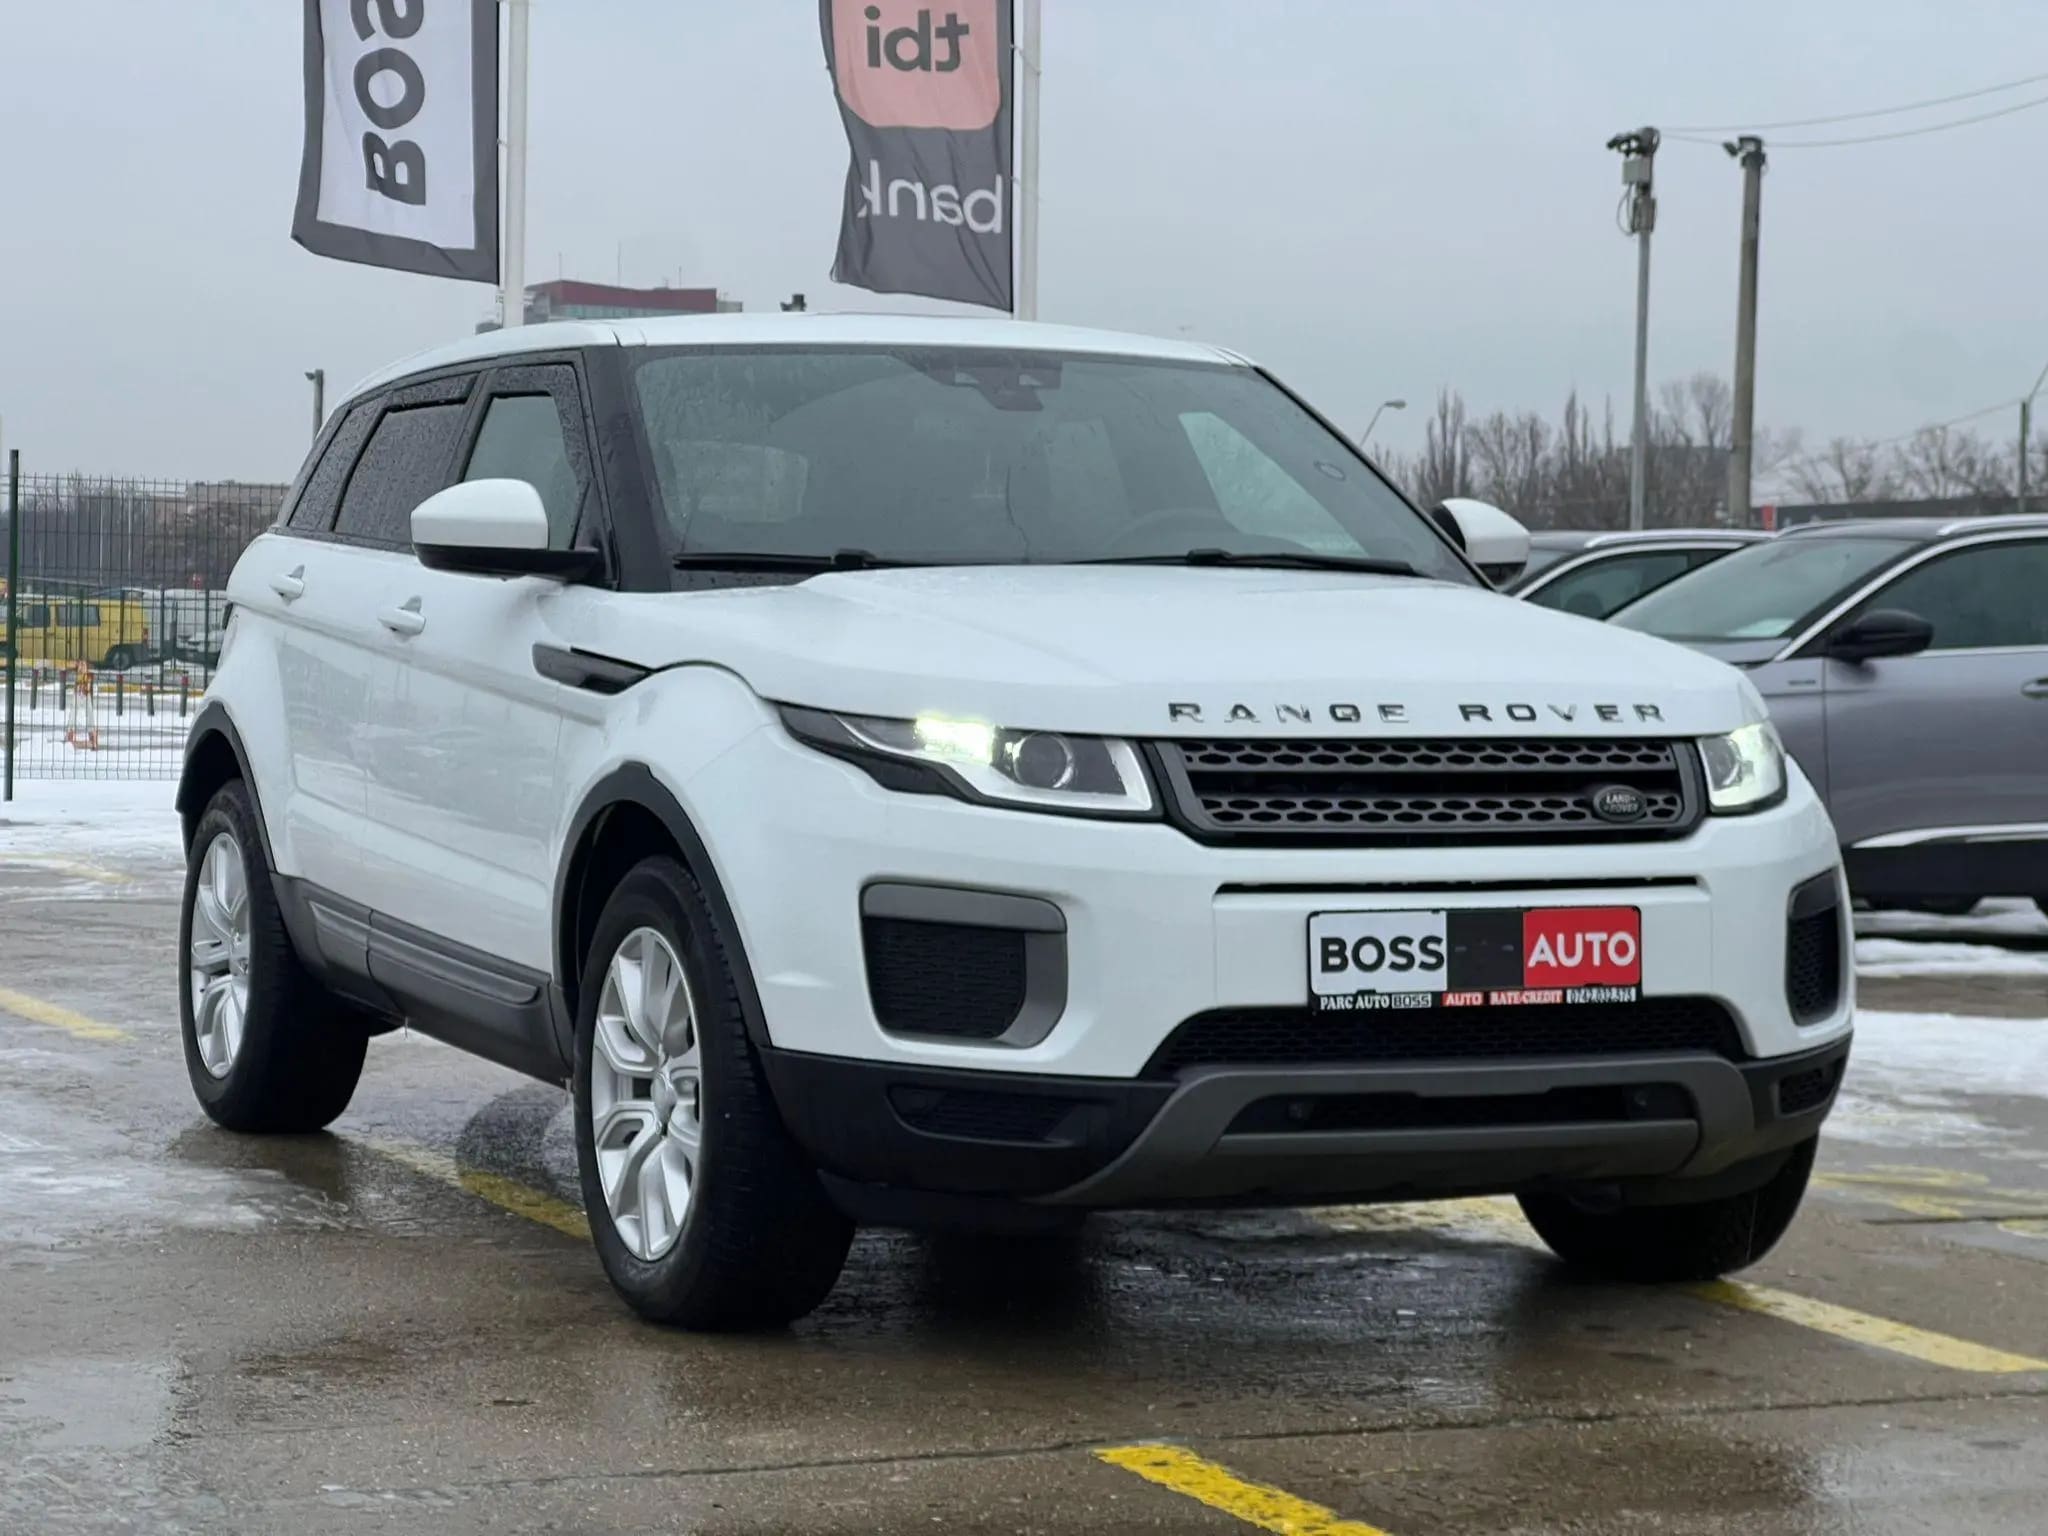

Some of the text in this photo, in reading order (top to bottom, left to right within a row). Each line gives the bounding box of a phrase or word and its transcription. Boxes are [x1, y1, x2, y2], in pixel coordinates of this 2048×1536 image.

[1168, 702, 1665, 723] RANGE ROVER
[1320, 932, 1636, 973] BOSS AUTO
[1320, 996, 1353, 1010] PARC
[1355, 994, 1390, 1009] AUTO
[1393, 993, 1431, 1009] BOSS
[1444, 992, 1483, 1006] AUTO
